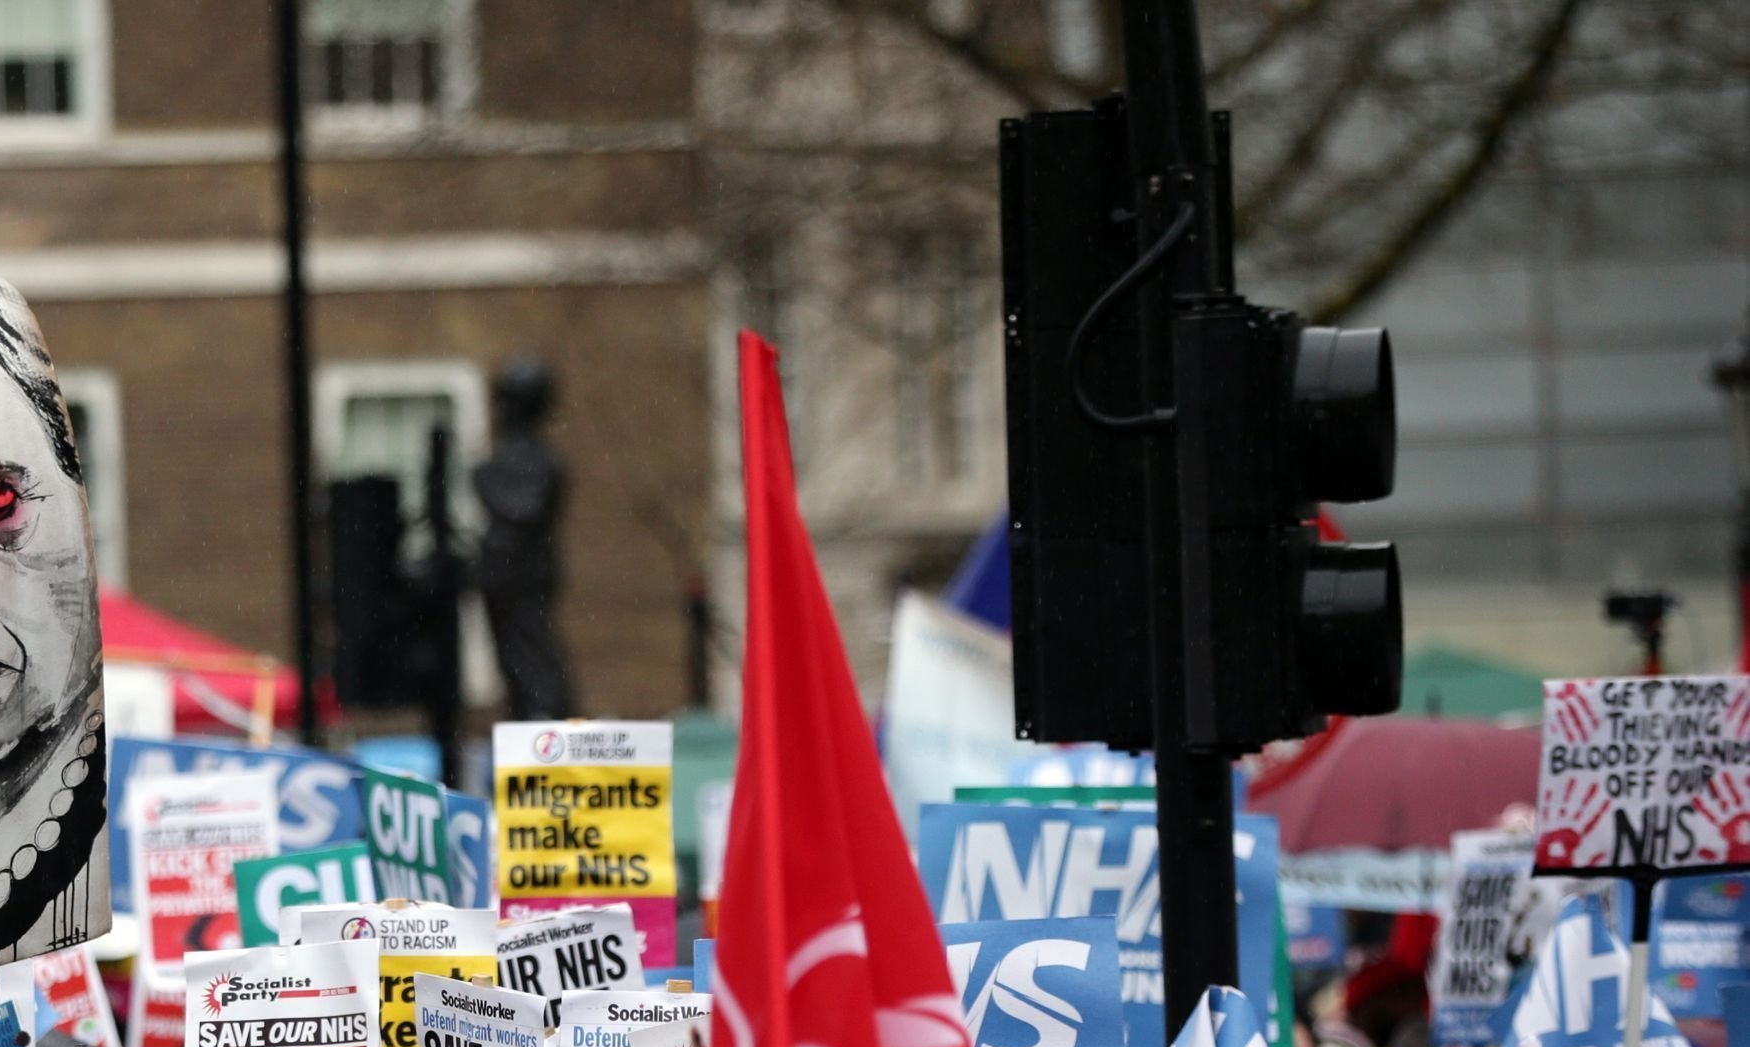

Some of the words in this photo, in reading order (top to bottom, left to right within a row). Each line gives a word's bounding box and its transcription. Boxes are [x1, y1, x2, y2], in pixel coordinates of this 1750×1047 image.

[1603, 681, 1664, 708] GET
[1670, 680, 1728, 708] YOUR
[1606, 711, 1722, 741] THIEVING
[1551, 744, 1661, 775] BLOODY
[507, 775, 661, 818] Migrants
[1606, 770, 1658, 799] OFF
[1667, 765, 1715, 796] OUR
[371, 781, 441, 870] CUT
[508, 819, 602, 851] make
[1613, 805, 1695, 866] NHS
[509, 863, 567, 889] our
[577, 855, 650, 888] NHS
[380, 920, 425, 934] STAND
[430, 920, 449, 933] UP
[380, 936, 398, 949] TO
[403, 935, 457, 949] RACISM
[498, 930, 547, 954] ocialist
[498, 953, 546, 997] UR
[555, 934, 627, 991] NHS
[228, 976, 311, 991] Socialist
[441, 990, 476, 1016] Socialist
[477, 998, 516, 1021] Worker
[607, 1003, 679, 1023] Socialist
[269, 1020, 318, 1044] OUR
[320, 1014, 368, 1043] NHS
[422, 1007, 457, 1033] Defend
[459, 1017, 493, 1042] migrant
